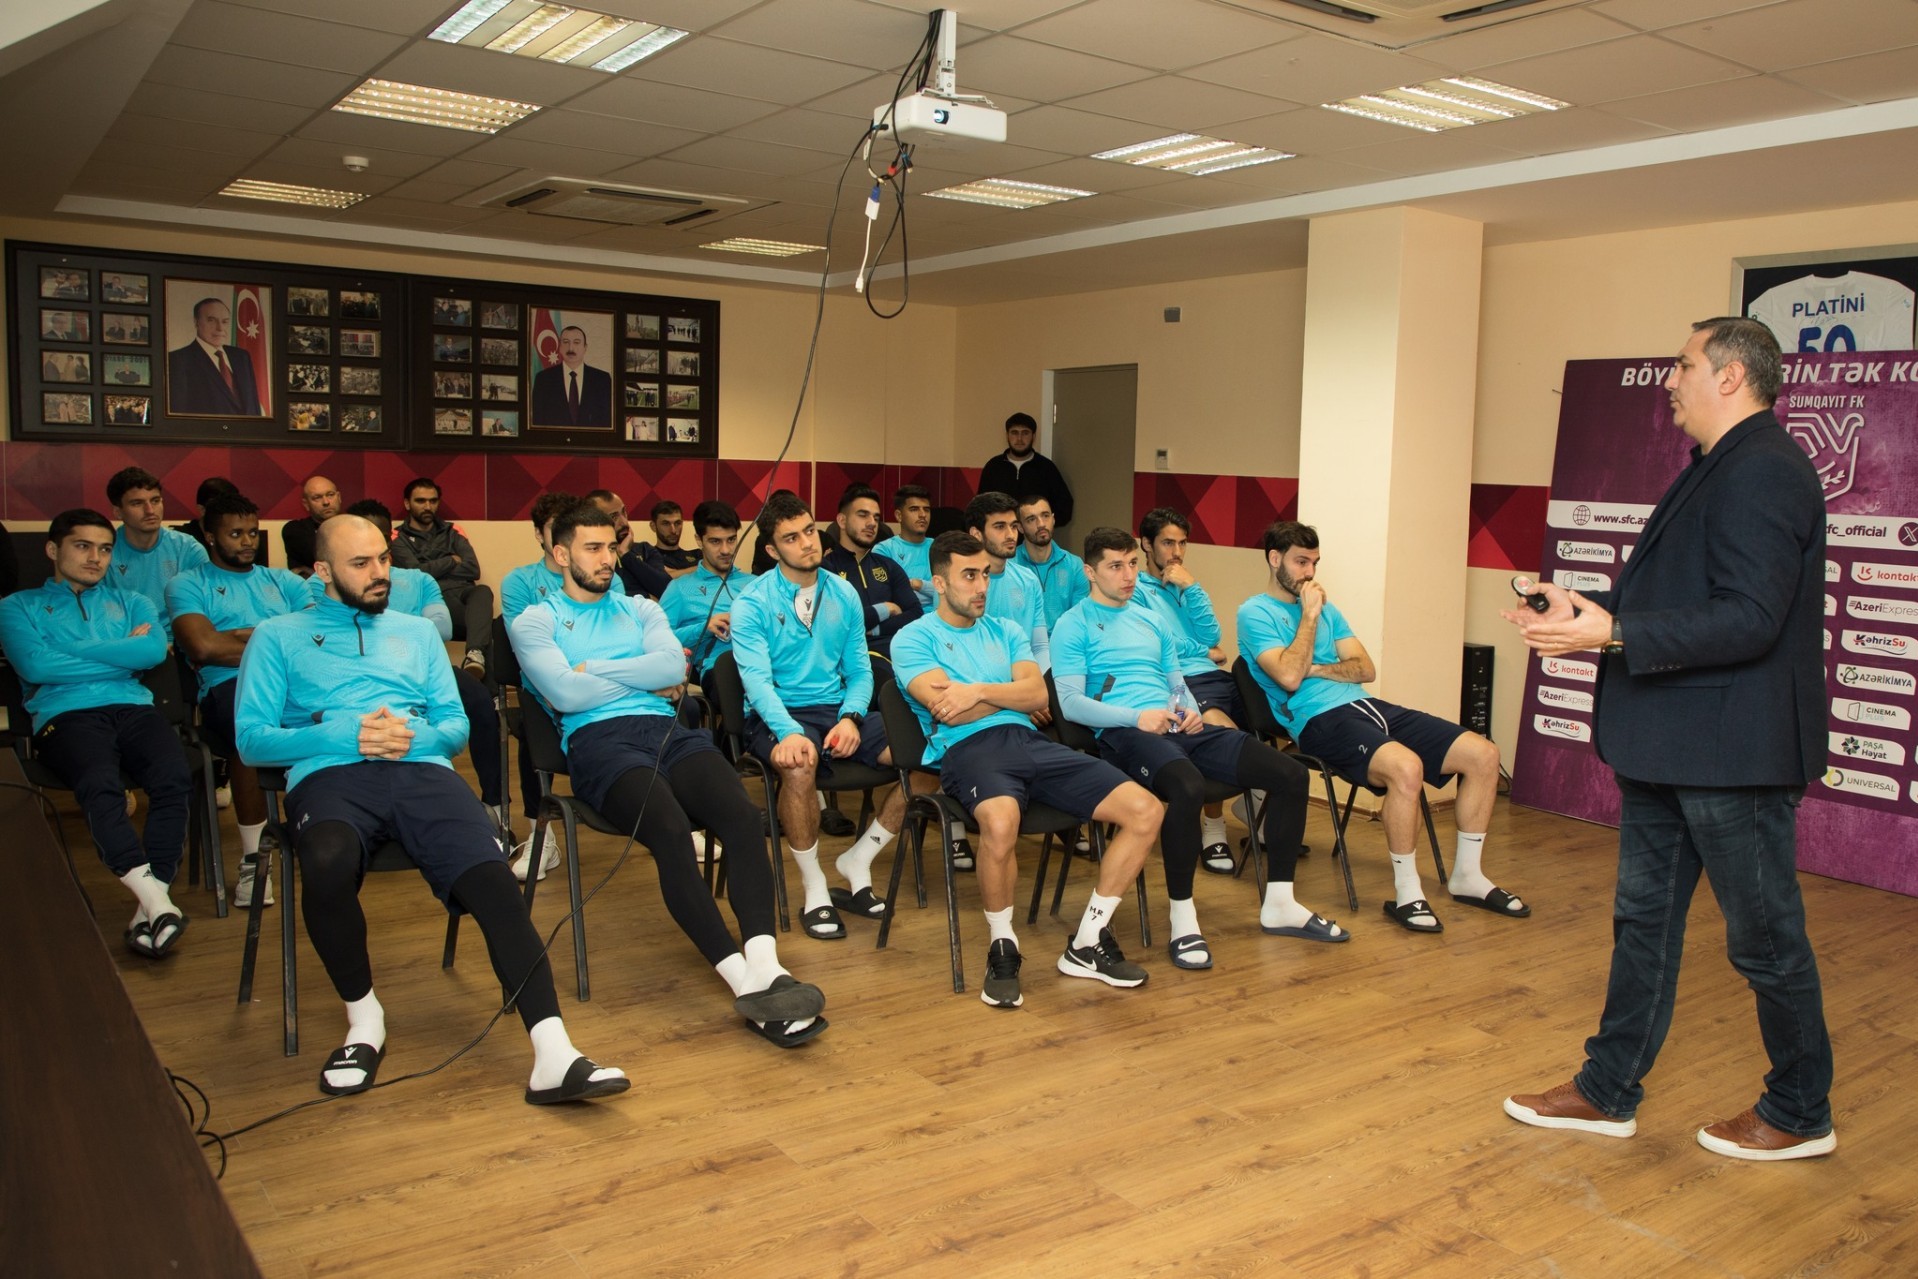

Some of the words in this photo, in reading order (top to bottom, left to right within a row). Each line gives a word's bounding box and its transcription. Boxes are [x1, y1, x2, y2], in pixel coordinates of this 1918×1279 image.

[1792, 292, 1865, 318] PLATİNİ
[1789, 395, 1847, 409] SUMQAYIT
[1850, 395, 1865, 408] FK
[1577, 575, 1600, 583] CINEMA
[1877, 570, 1918, 582] kontak
[1561, 665, 1594, 677] kontakt
[1866, 707, 1897, 717] CINEMA
[1847, 777, 1896, 793] UNIVERSAL
